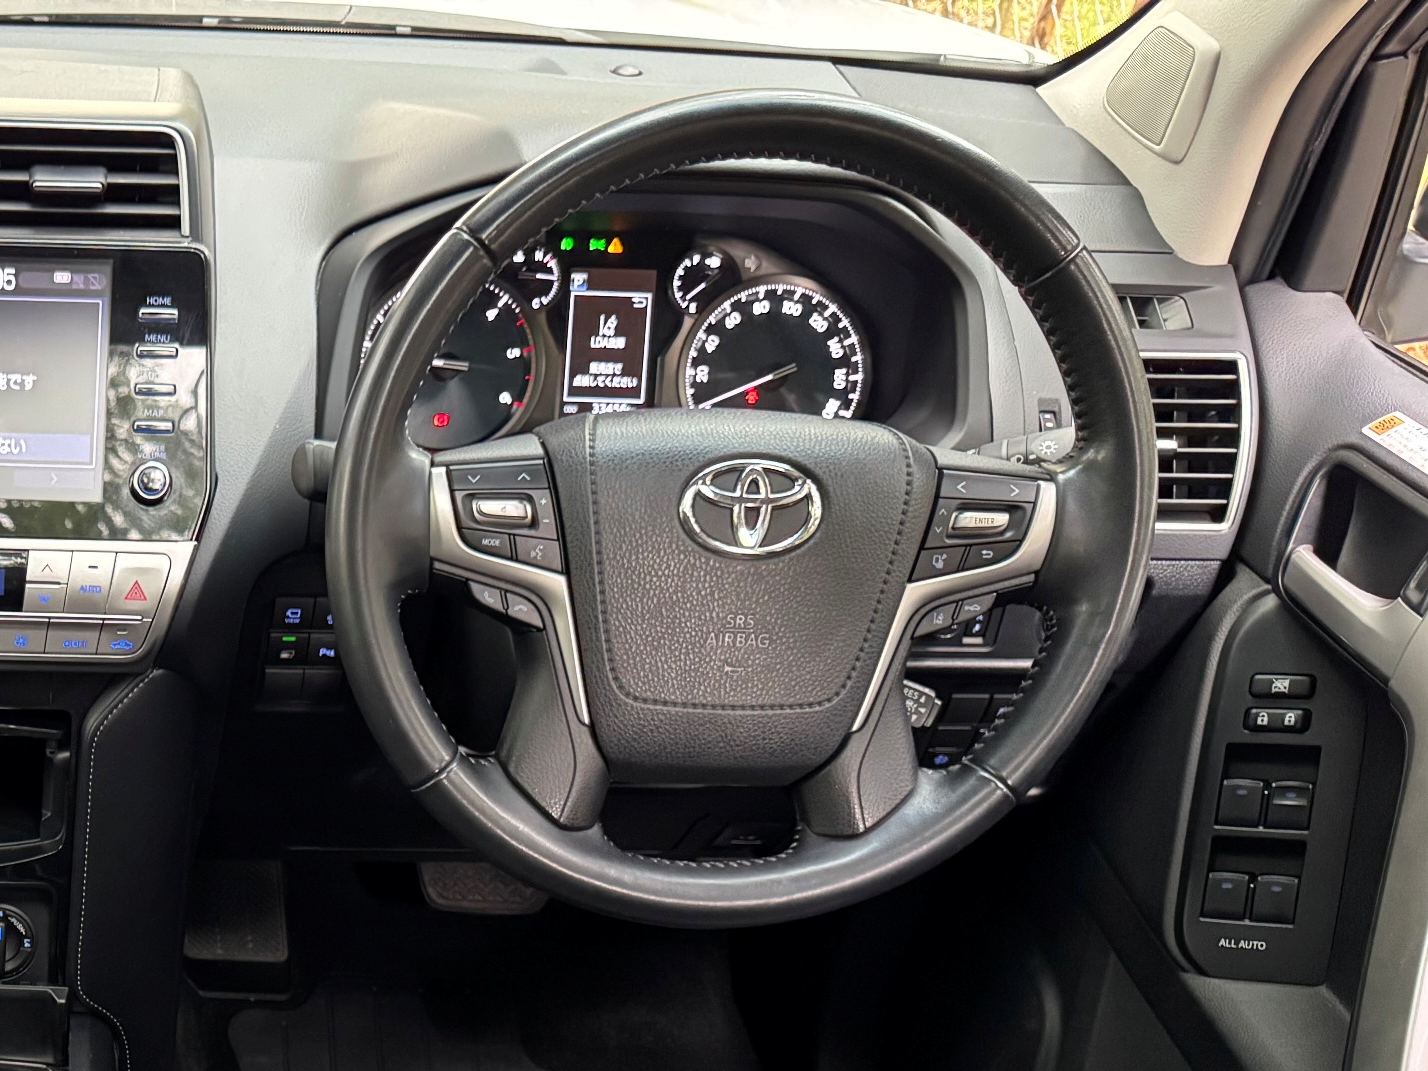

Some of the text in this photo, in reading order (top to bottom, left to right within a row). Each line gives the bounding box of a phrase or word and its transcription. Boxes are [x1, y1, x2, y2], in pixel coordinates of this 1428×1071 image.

[146, 296, 172, 306] HOME
[752, 300, 771, 316] 80
[781, 300, 803, 316] 100
[724, 312, 742, 330] 60
[808, 312, 830, 333] 120
[144, 333, 171, 343] MENU
[704, 335, 720, 354] 40
[506, 347, 522, 360] 5
[826, 336, 845, 359] 140
[695, 365, 710, 384] 20
[833, 368, 848, 390] 160
[144, 408, 164, 417] MAP
[974, 516, 995, 525] ENTER
[481, 538, 500, 547] MODE
[79, 584, 102, 594] AUTO
[725, 614, 755, 628] SRS
[705, 632, 770, 648] AIRBAG
[903, 687, 920, 700] RES
[1218, 938, 1266, 950] ALL AUTO
